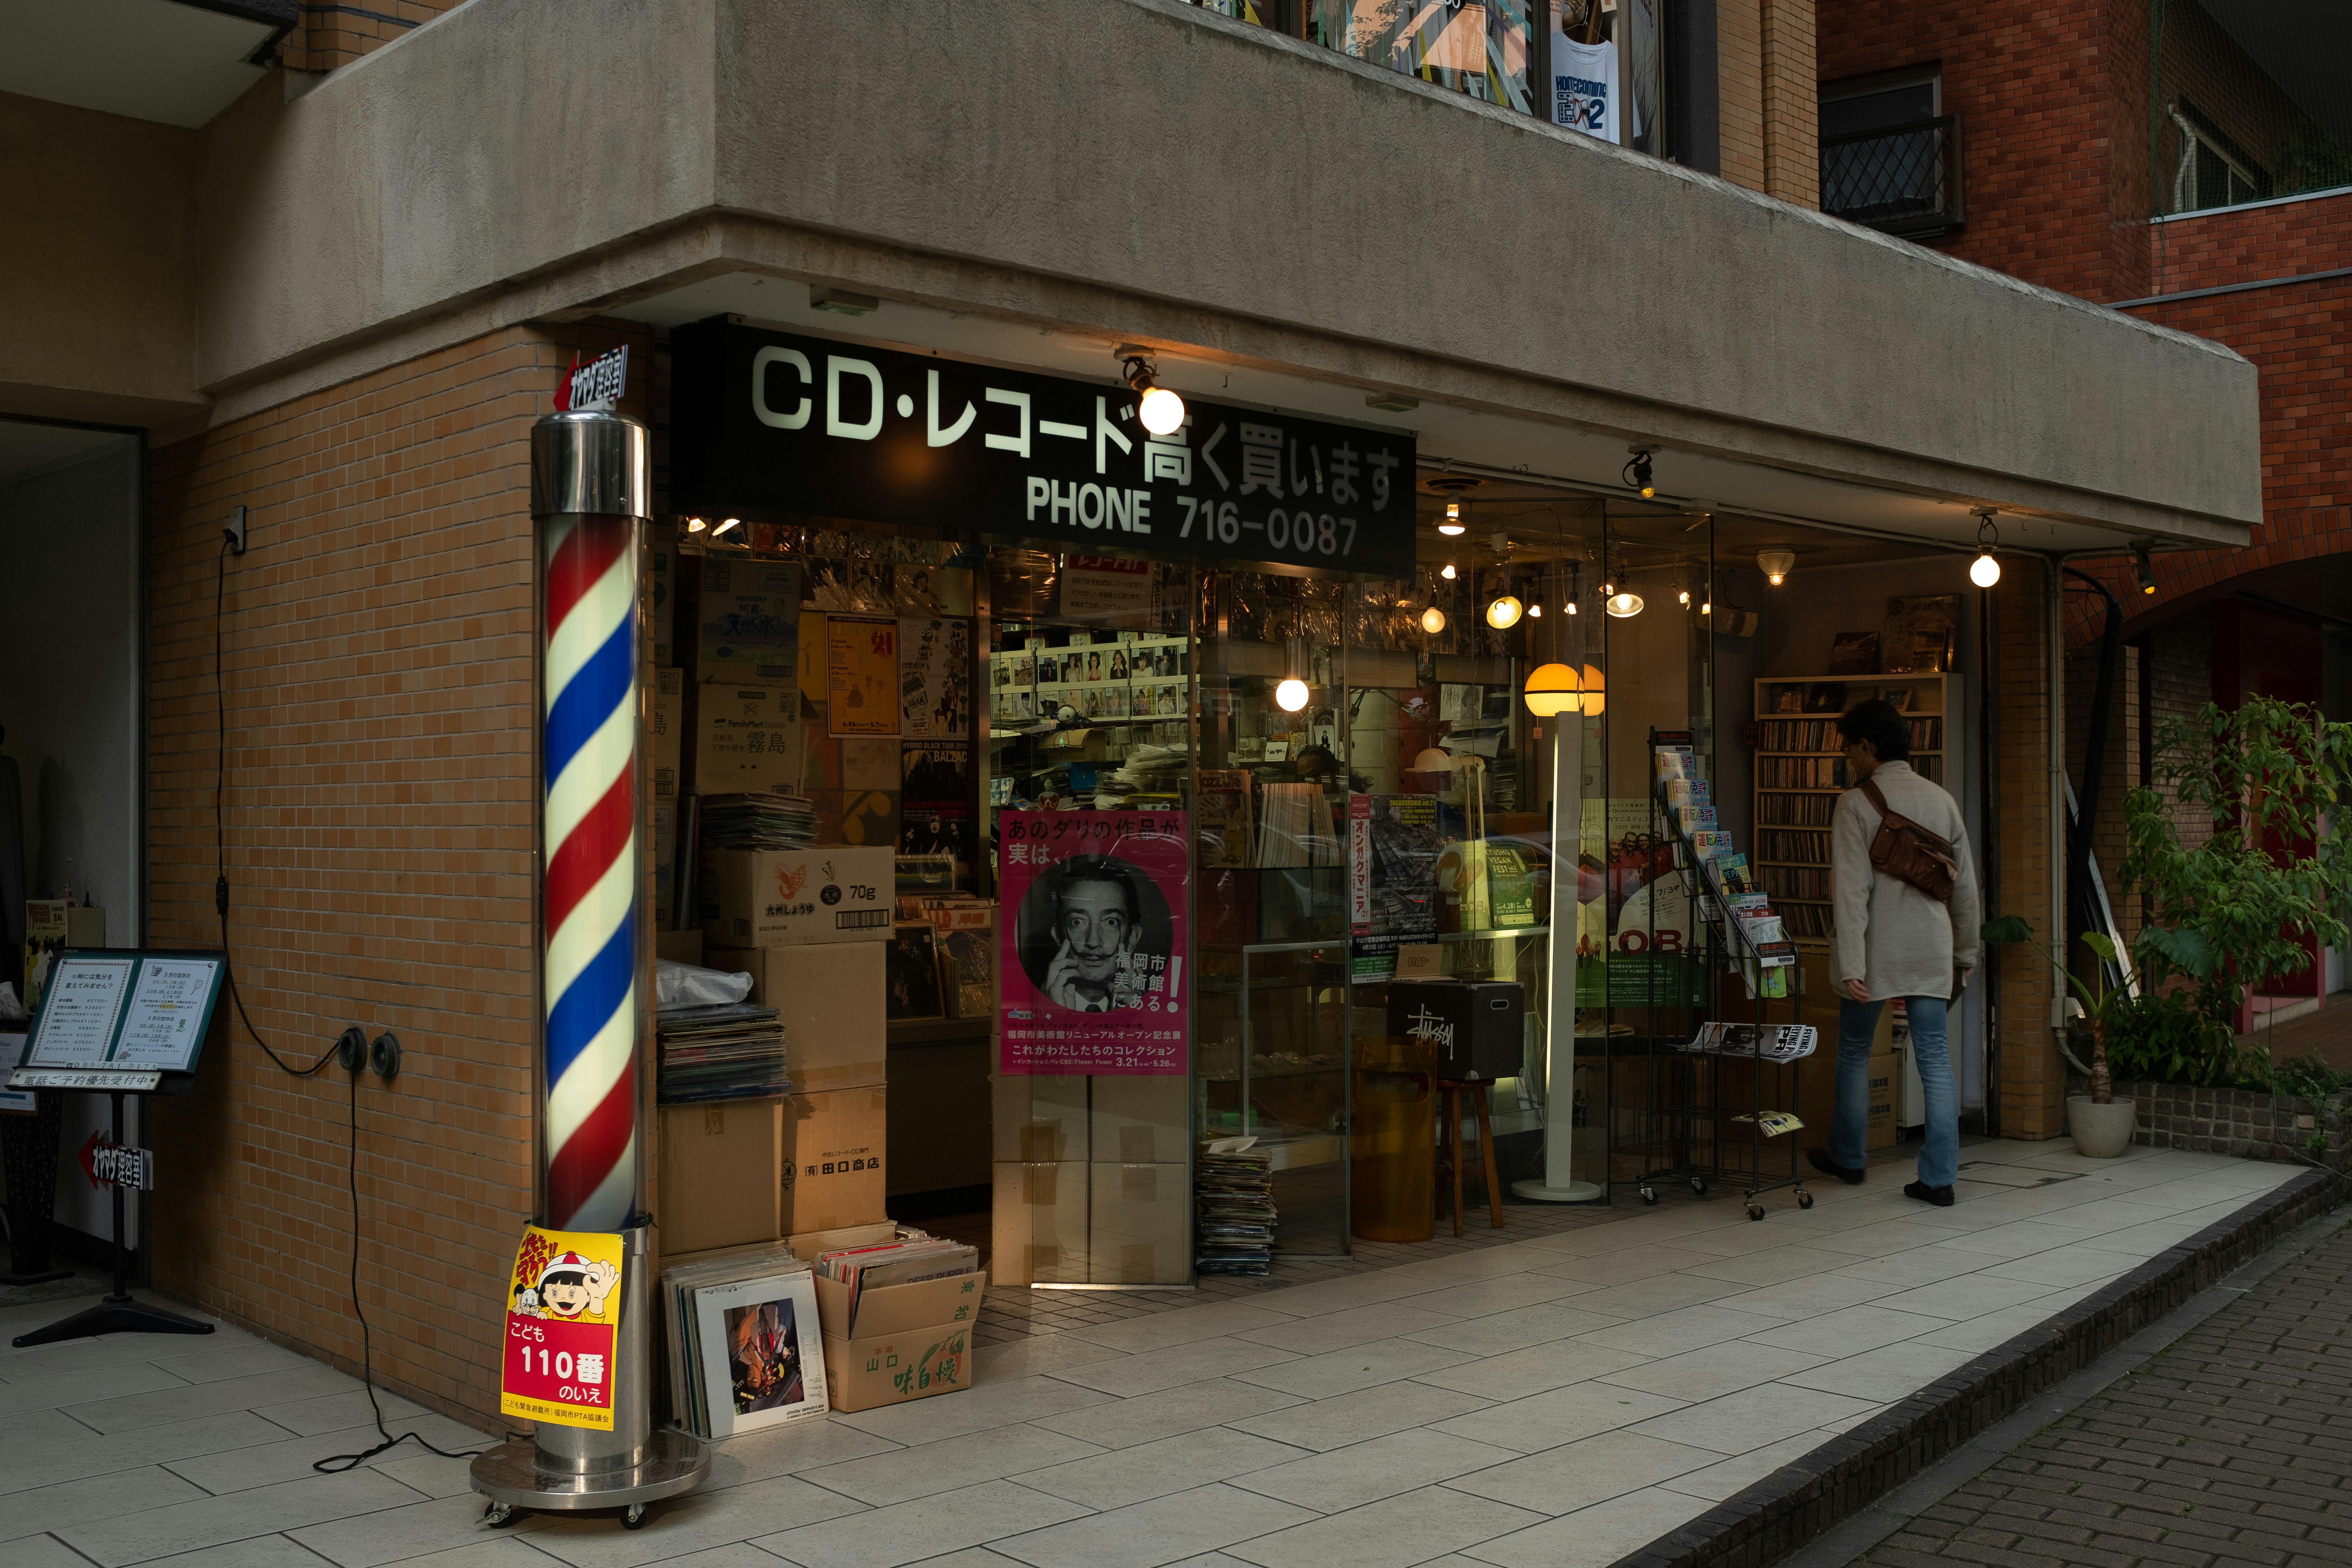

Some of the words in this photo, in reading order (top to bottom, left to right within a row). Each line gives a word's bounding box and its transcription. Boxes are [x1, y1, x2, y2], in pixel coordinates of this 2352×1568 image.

[1027, 475, 1151, 534] PHONE
[1176, 495, 1358, 557] 716-0087
[721, 614, 780, 639] 天然水
[728, 720, 764, 729] FamilyMart
[747, 731, 786, 754] 霧島
[934, 751, 968, 762] BALZAC
[1008, 818, 1180, 841] あのダリの作品が
[1008, 842, 1060, 866] 実は、
[1356, 820, 1365, 914] オンガクマニア
[849, 885, 876, 900] 70g
[54, 913, 64, 922] BAL
[765, 902, 815, 918] 九州しょうゆ
[935, 910, 952, 929] LD
[1115, 950, 1166, 972] 福岡市
[1114, 971, 1165, 993] 美術館
[1113, 992, 1160, 1012] にある
[1007, 1029, 1181, 1040] 福岡市美術館リニューアルオープン記念展
[1786, 1026, 1802, 1046] FLYING
[1799, 1029, 1812, 1049] FLYING
[1012, 1044, 1176, 1056] これがわたしたちのコレクション
[24, 1075, 148, 1085] 電話ご予約優先受付中
[822, 1147, 869, 1158] 中古レコード・CD専門
[93, 1145, 140, 1186] オヤマダ理容室
[822, 1156, 879, 1175] 田口商店
[511, 1322, 545, 1343] こども
[874, 1345, 893, 1356] 本場
[522, 1346, 604, 1384] 110番
[866, 1354, 898, 1373] 山口
[893, 1356, 958, 1396] 味自慢
[559, 1385, 603, 1404] のいえ
[502, 1397, 553, 1416] (こども緊急避難所)
[554, 1408, 609, 1424] 福岡市PTA協議会
